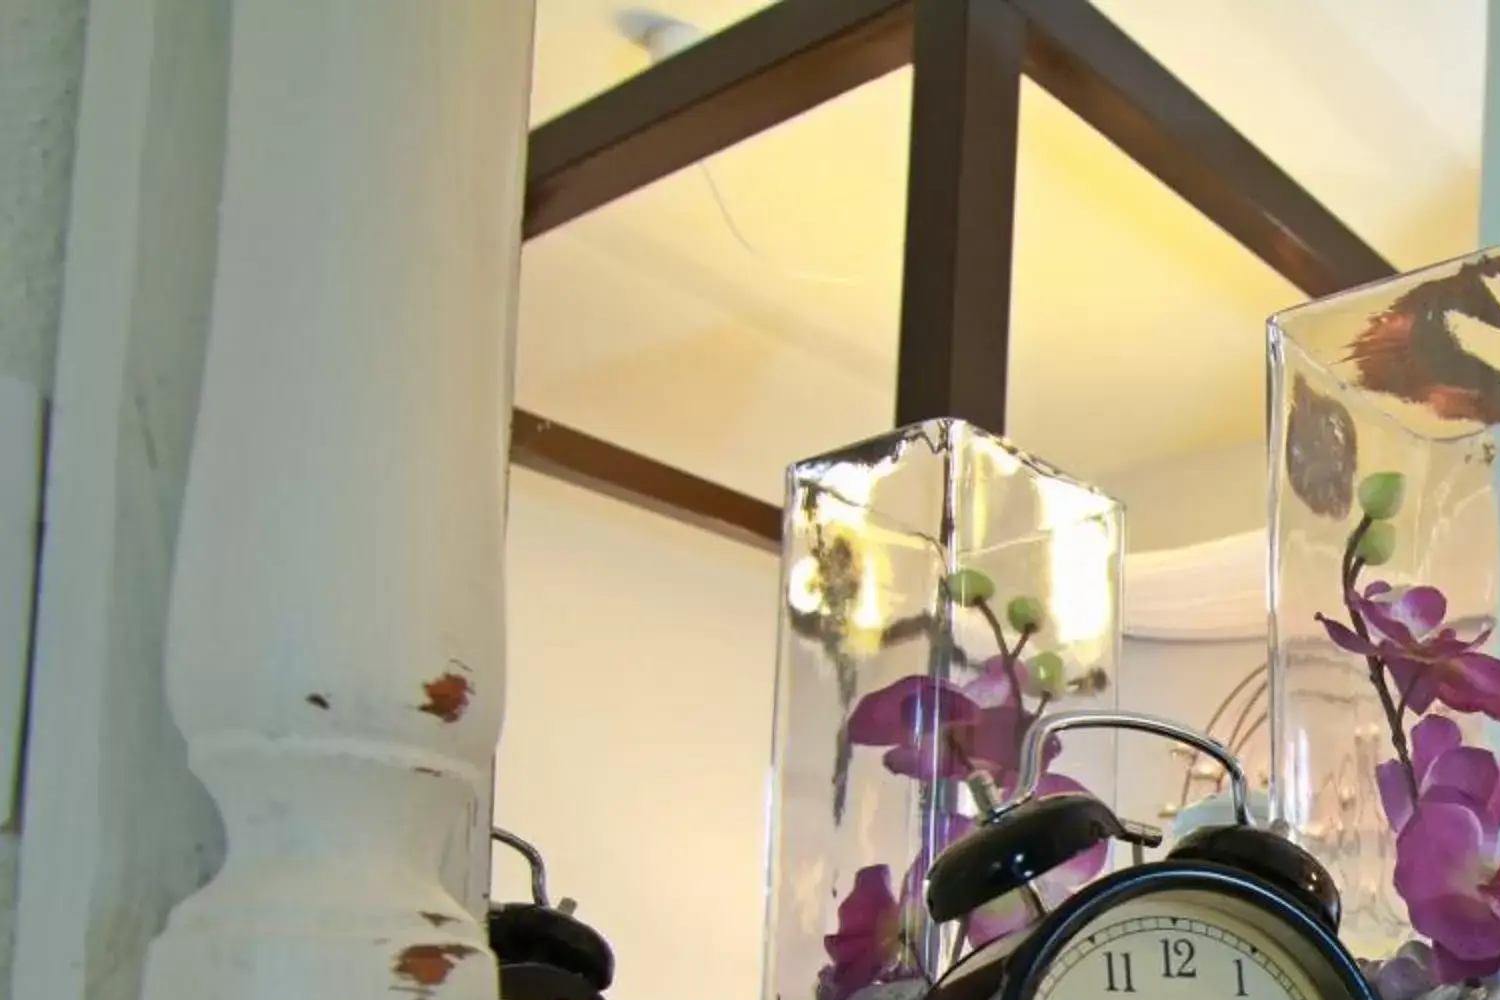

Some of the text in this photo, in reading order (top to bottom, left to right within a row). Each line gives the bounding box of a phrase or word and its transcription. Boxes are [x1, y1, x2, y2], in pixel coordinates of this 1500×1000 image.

[1103, 950, 1136, 992] 11
[1159, 938, 1197, 978] 12
[1233, 959, 1249, 996] 1
